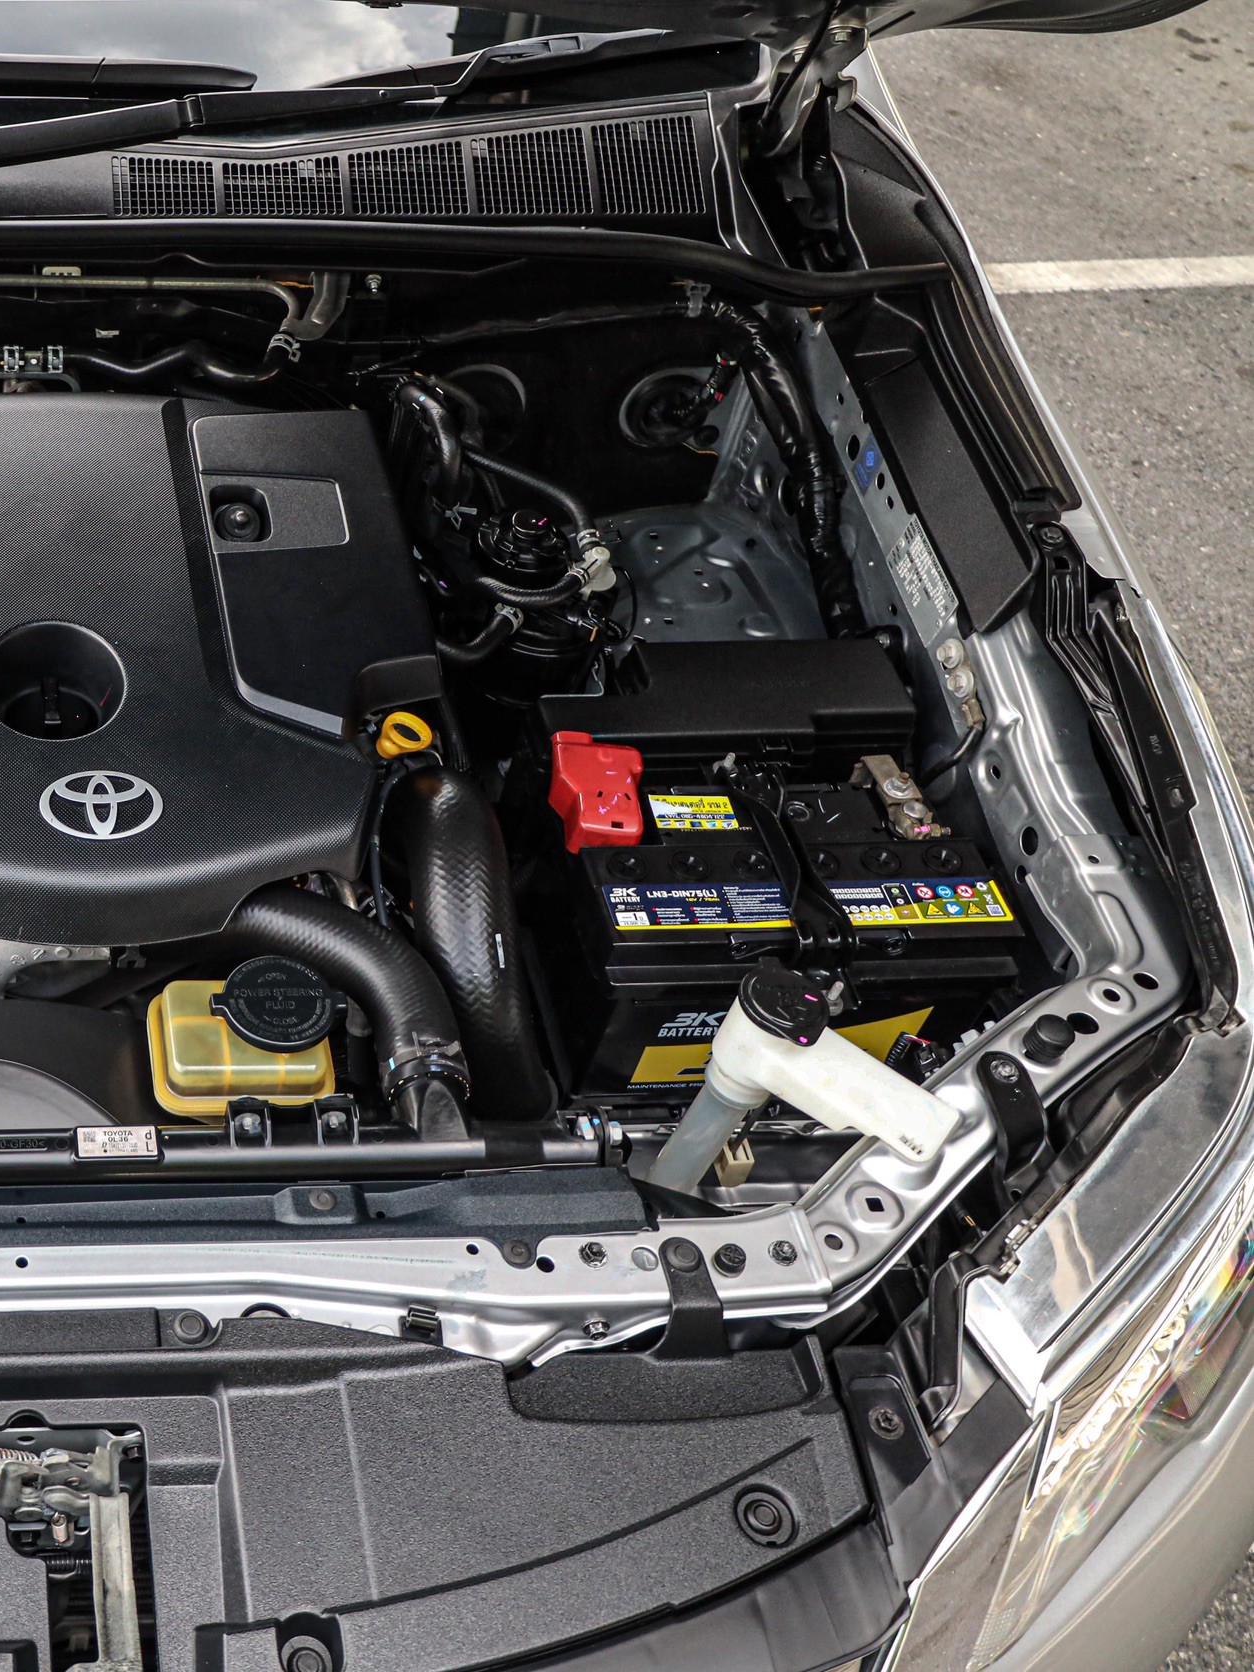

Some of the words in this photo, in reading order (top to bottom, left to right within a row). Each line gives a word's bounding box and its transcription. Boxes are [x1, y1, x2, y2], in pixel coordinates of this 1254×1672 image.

[609, 887, 637, 897] 3K
[647, 889, 718, 898] LN3-DIN75(L)
[266, 972, 286, 980] OPEN
[234, 989, 271, 997] POWER
[273, 988, 323, 997] STEERING
[266, 1001, 296, 1009] FLUID
[662, 1011, 728, 1028] 3K
[144, 1130, 152, 1140] d
[146, 1142, 154, 1153] L
